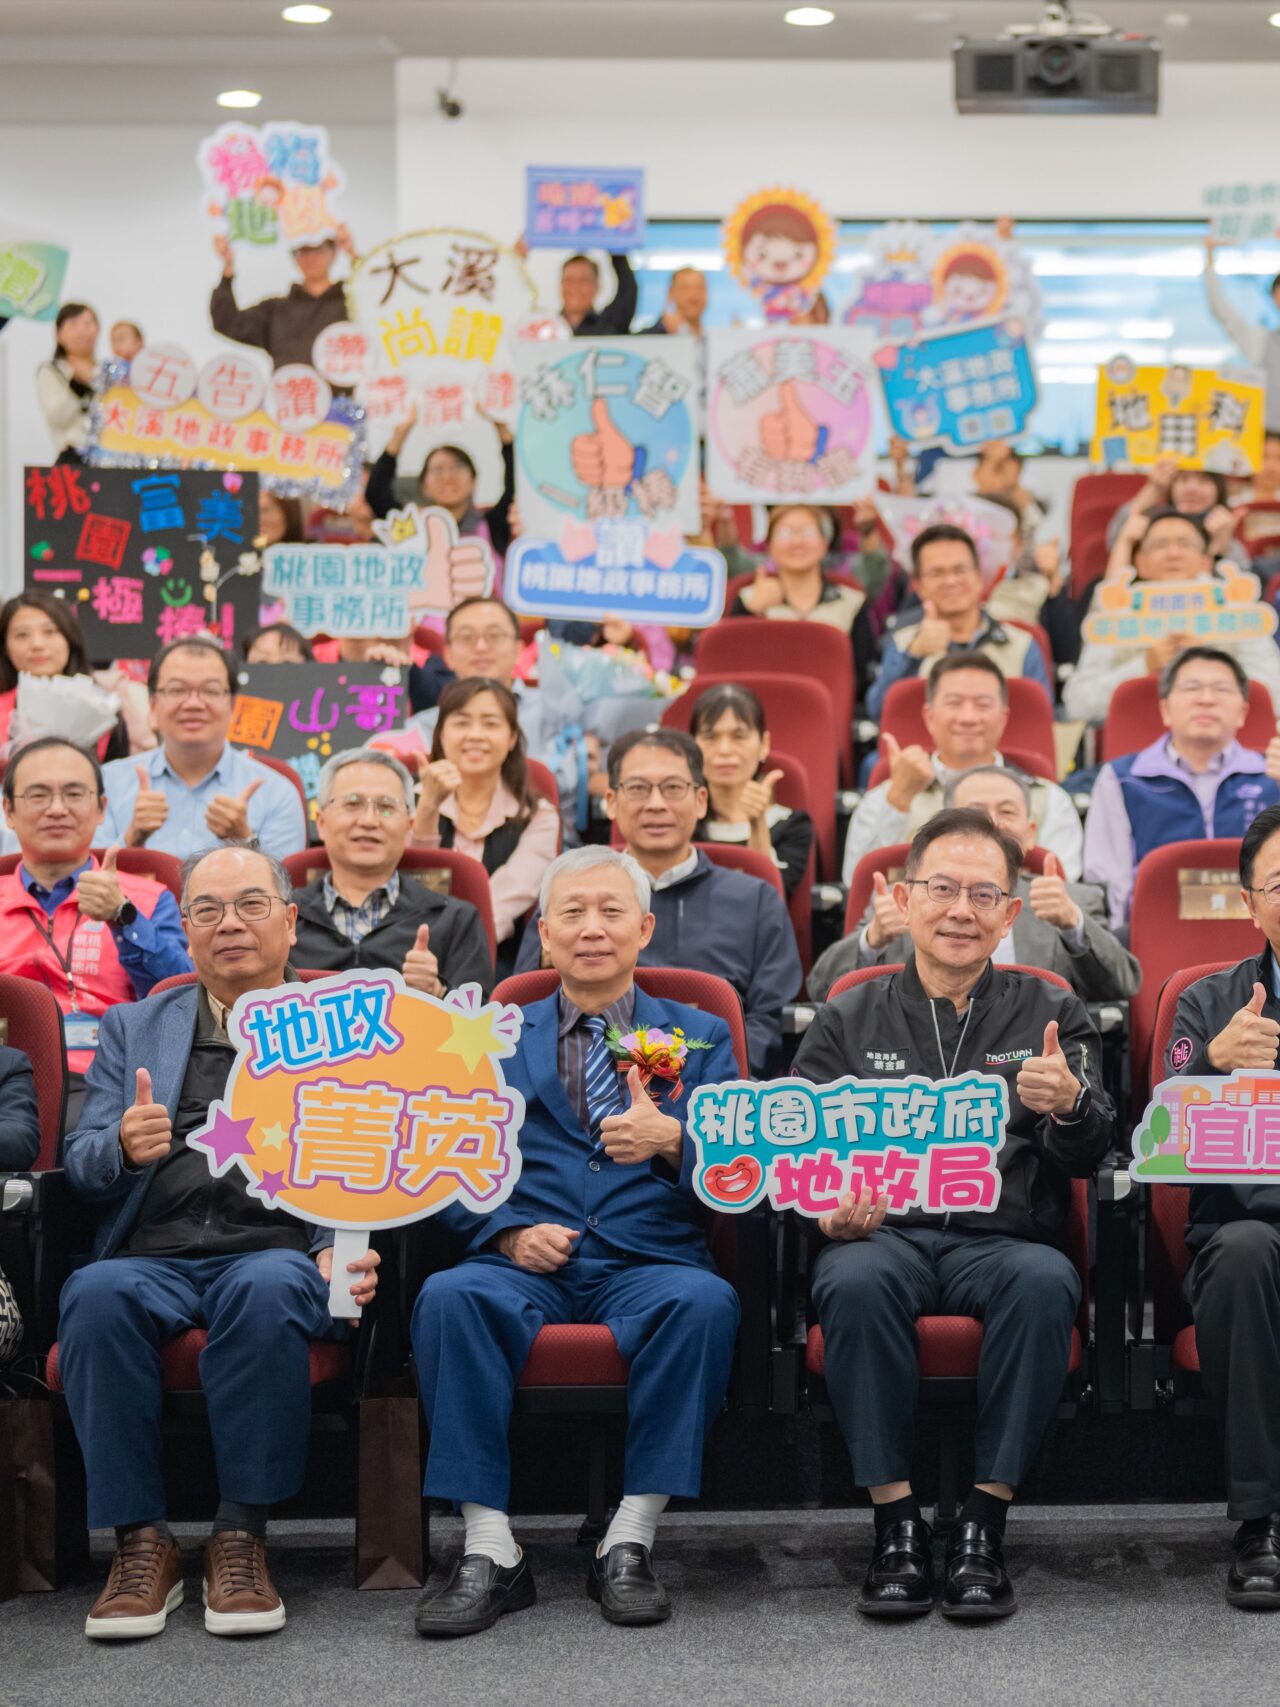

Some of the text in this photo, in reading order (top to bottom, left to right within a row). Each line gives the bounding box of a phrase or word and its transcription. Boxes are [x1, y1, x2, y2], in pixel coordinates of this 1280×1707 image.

[370, 244, 499, 306] 大溪
[145, 351, 318, 424] 五告讚
[104, 402, 346, 472] 大溪地政事務所
[27, 466, 132, 570] 桃園
[131, 474, 244, 544] 富美
[272, 551, 426, 590] 桃園地政
[292, 593, 405, 629] 事務所
[248, 988, 396, 1072] 地政
[985, 1048, 1033, 1063] TAOYUAN
[297, 1085, 506, 1194] 菁英
[699, 1084, 1000, 1148] 桃園市政府
[773, 1144, 999, 1213] 地政局
